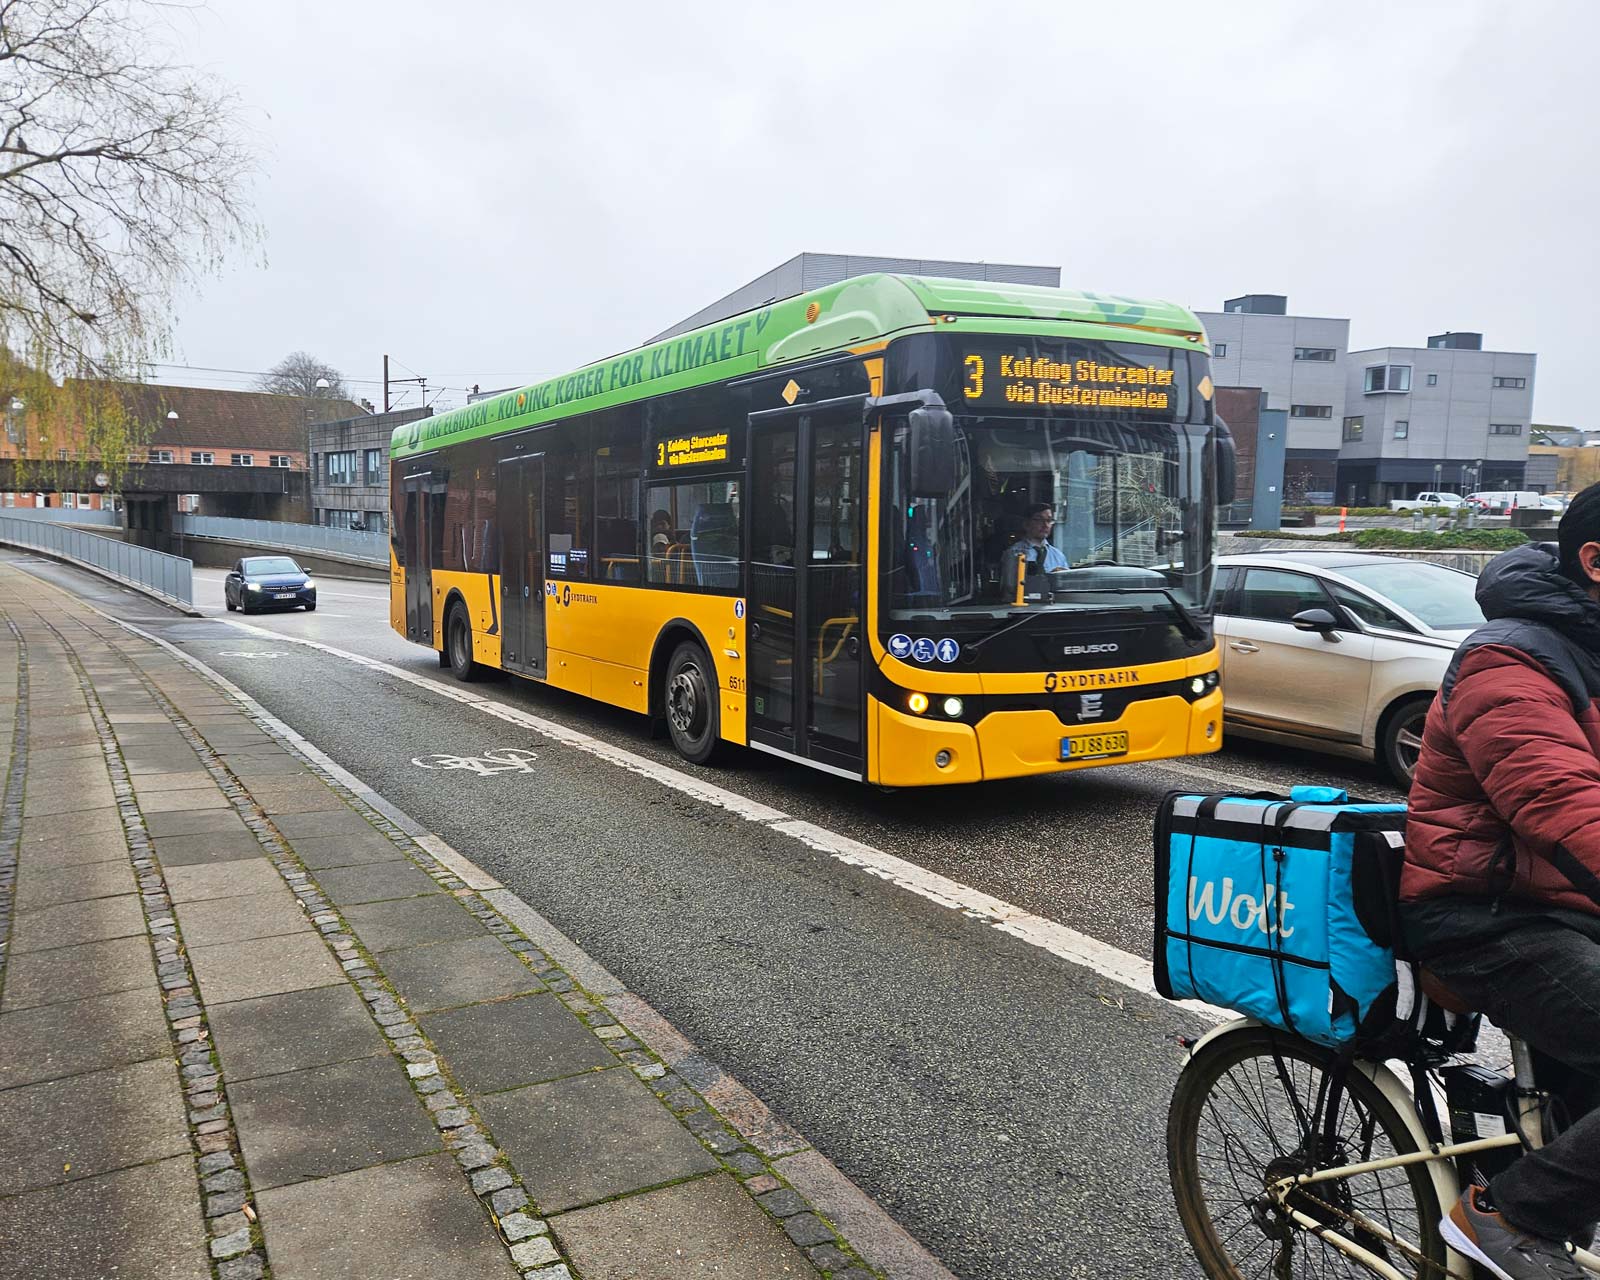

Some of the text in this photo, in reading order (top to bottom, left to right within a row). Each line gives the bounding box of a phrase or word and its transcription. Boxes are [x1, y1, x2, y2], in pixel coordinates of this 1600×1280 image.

[426, 421, 441, 439] TAG
[444, 404, 489, 434] ELBUSSEN
[498, 383, 553, 420] KOLDING
[555, 367, 605, 405] KØRER
[609, 354, 644, 390] FOR
[650, 319, 752, 380] KLIMAET
[963, 354, 985, 398] 3
[1000, 354, 1174, 386] Kolding Storcenter
[1005, 381, 1168, 408] via Busterminalen
[657, 443, 665, 466] 3
[571, 593, 598, 604] SYDTRAFIK
[1063, 643, 1119, 655] EBUSCO
[729, 676, 745, 691] 6511
[1061, 671, 1140, 688] SYDTRAFIK
[1070, 734, 1126, 754] DJ 88 630
[1188, 876, 1295, 938] Wolt
